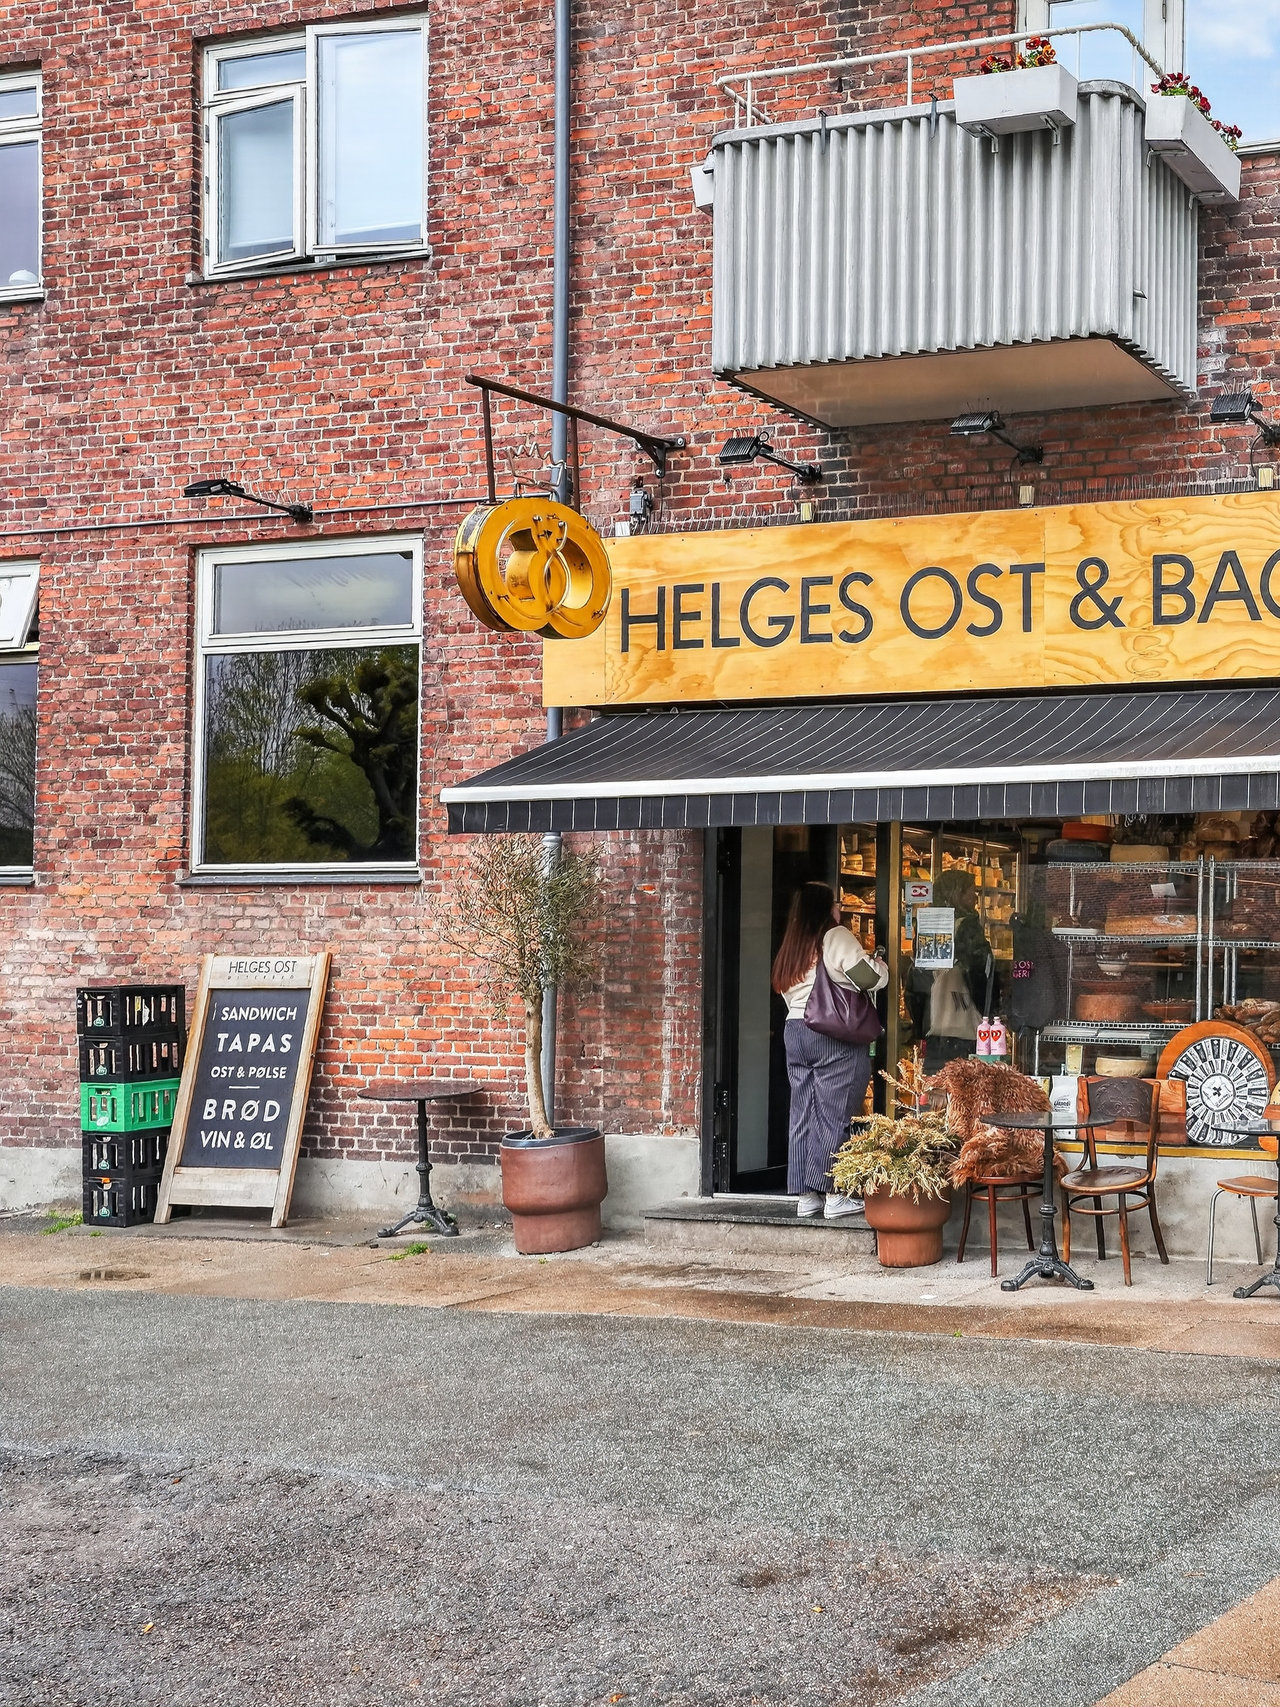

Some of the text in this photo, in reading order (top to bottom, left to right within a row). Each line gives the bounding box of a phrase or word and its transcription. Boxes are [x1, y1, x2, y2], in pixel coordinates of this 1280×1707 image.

[621, 570, 874, 654] HELGES
[900, 562, 1045, 640] OST
[1069, 556, 1127, 631] &
[228, 960, 298, 974] HELGES OST
[221, 1006, 298, 1021] SANDWICH
[217, 1032, 293, 1053] TAPAS
[210, 1066, 288, 1079] OST & PØLSE
[202, 1098, 281, 1122] BRØD
[200, 1130, 274, 1150] VIN & ØL
